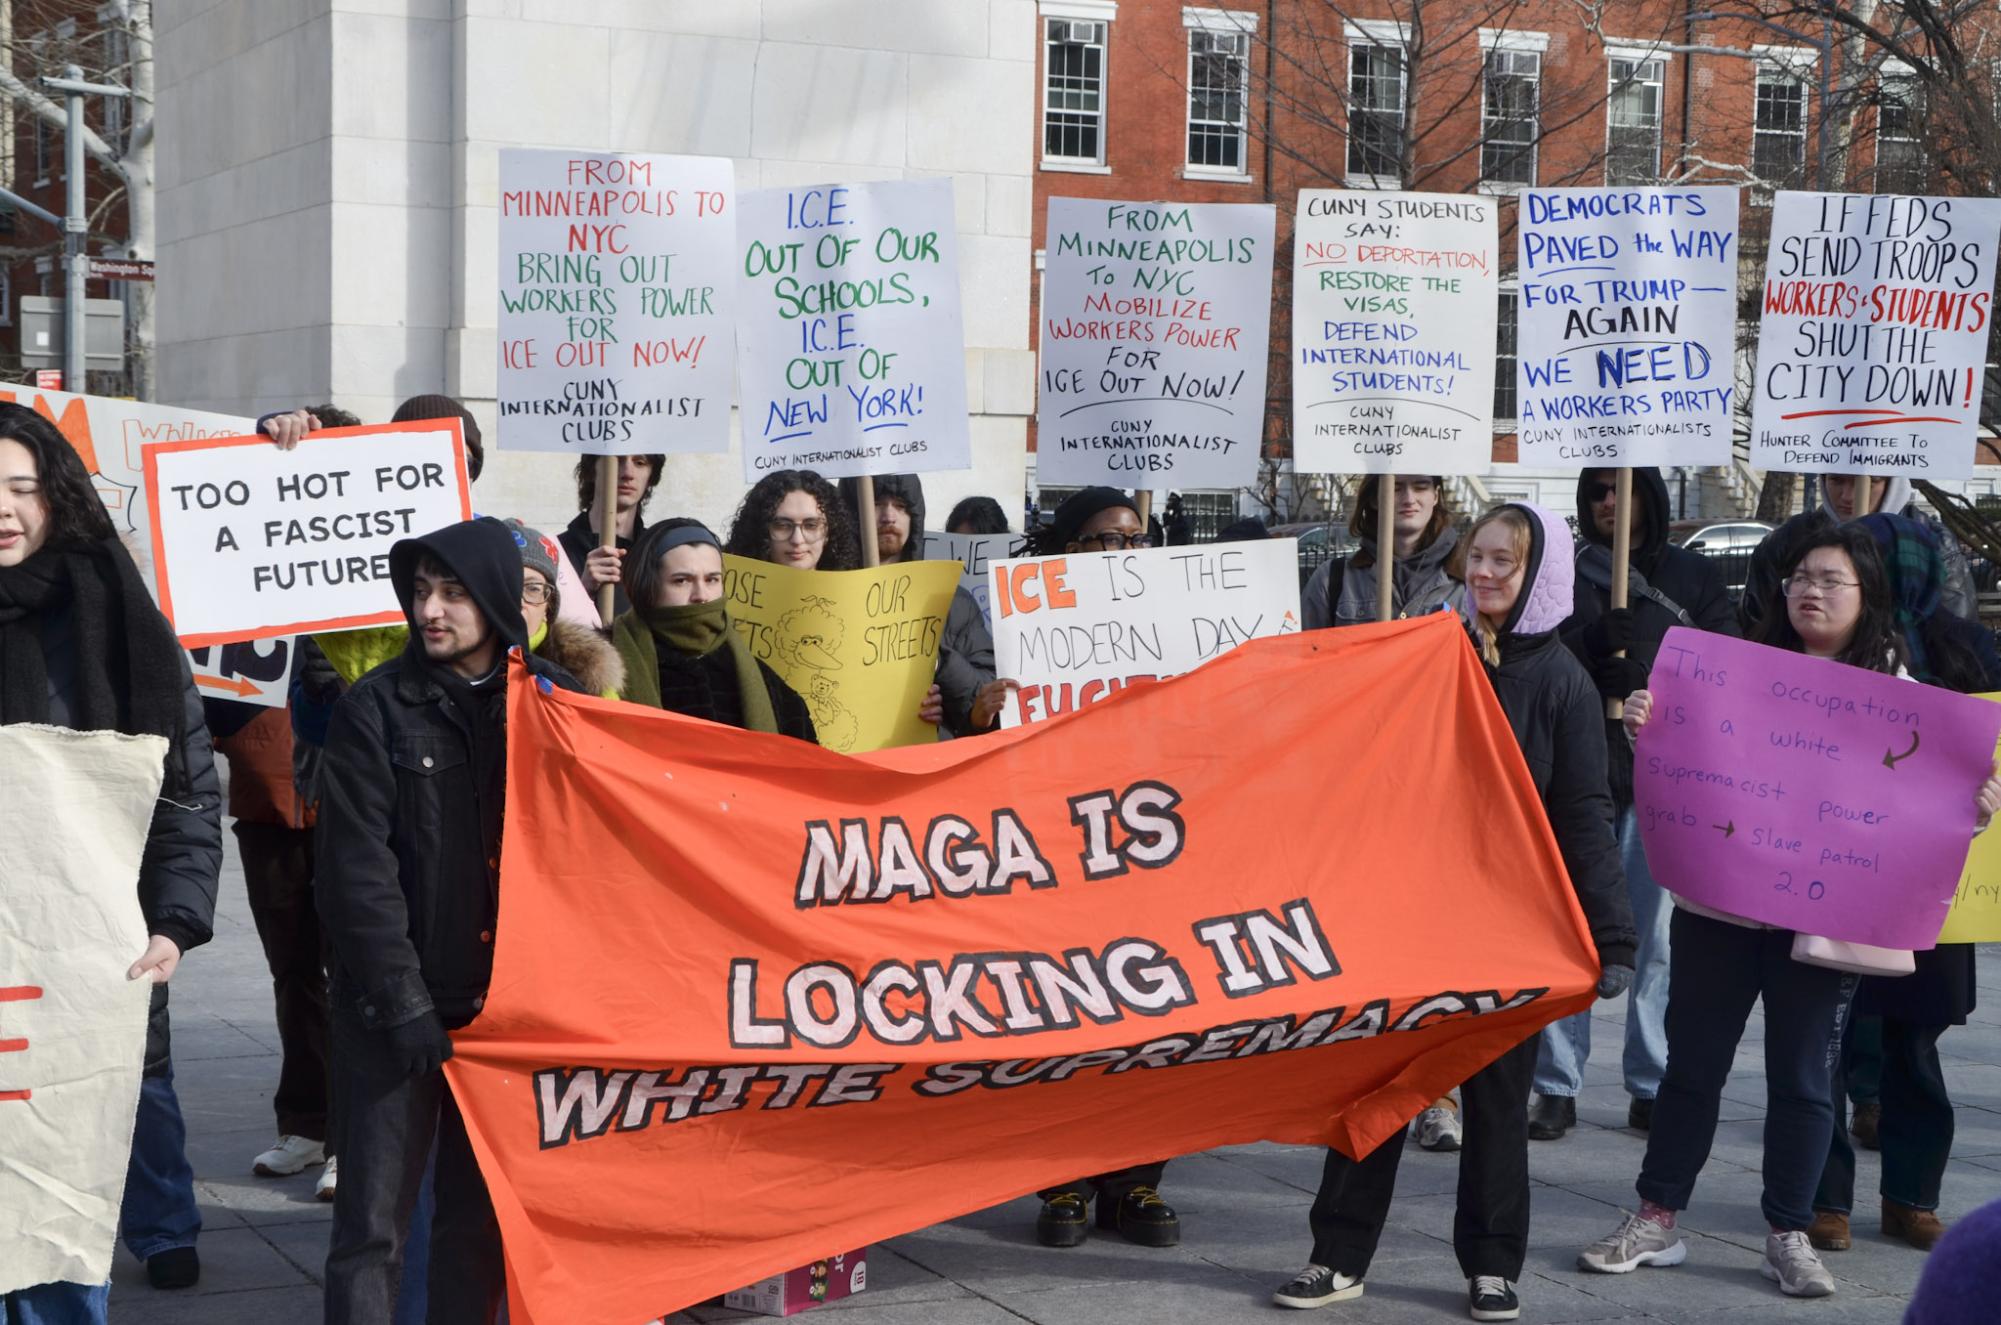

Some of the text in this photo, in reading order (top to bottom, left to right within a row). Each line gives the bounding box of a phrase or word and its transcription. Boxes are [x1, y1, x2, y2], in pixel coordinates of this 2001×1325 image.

[568, 160, 651, 186] FROM
[503, 190, 725, 217] MINNEAPOLIS TO
[787, 188, 854, 229] I.C.E.
[1108, 204, 1194, 233] FROM
[1308, 197, 1485, 223] CUNY STUDENTS
[1528, 193, 1707, 225] DEMOCRATS
[1813, 196, 1952, 242] IF FEDS
[568, 224, 629, 254] NYC
[1344, 223, 1400, 239] SAY:
[745, 227, 940, 278] OUT OF OUR
[1057, 232, 1255, 265] MINNEAPOLIS
[1306, 241, 1490, 277] NO DEPORTATION,
[1524, 228, 1733, 268] PAVED the WAY
[1779, 236, 1980, 289] SEND TROOPS
[91, 262, 139, 276] Washington
[518, 253, 679, 287] BRING OUT
[1133, 266, 1195, 296] NYC
[1319, 271, 1461, 293] RESTORE THE
[500, 287, 714, 317] WORKERS POWER
[774, 272, 929, 320] SCHOOLS,
[1084, 292, 1213, 321] MOBILIZE
[1344, 296, 1414, 319] VISAS,
[1524, 284, 1582, 308] FOR
[1765, 279, 1859, 319] WORKERS
[1870, 284, 1990, 333] STUDENTS
[567, 316, 618, 343] FOR
[802, 314, 865, 353] I.C.E.
[1049, 318, 1241, 351] WORKERS POWER
[1324, 321, 1418, 341] DEFEND
[1563, 304, 1680, 340] AGAIN
[503, 335, 706, 370] ICE OUT NOW!
[1107, 346, 1161, 371] FOR
[1794, 321, 1937, 364] SHUT THE
[786, 348, 898, 390] OUT OF
[1302, 348, 1471, 371] INTERNATIONAL
[1524, 341, 1712, 389] WE NEED
[563, 378, 623, 401] CUNY
[1100, 369, 1146, 394] OUT
[1161, 369, 1245, 400] NOW!
[1332, 371, 1454, 396] STUDENTS!
[1767, 362, 1973, 408] CITY DOWN!
[500, 397, 705, 417] INTERNATIONALIST
[764, 383, 923, 436] NEW YORK!
[1349, 406, 1394, 420] CUNY
[1523, 387, 1733, 423] A WORKERS PARTY
[562, 419, 634, 443] CLUBS
[1111, 419, 1153, 433] CUNY
[1314, 424, 1462, 441] INTERNATIONALIST
[1523, 422, 1712, 445] CUNY INTERNATIONALISTS
[1760, 431, 1811, 447] HUNTER
[1822, 430, 1899, 448] COMMITTEE
[754, 441, 928, 470] CUNY INTERNATIONALIST CLUBS
[1061, 434, 1238, 455] INTERNATIONALIST
[1354, 443, 1404, 456] CLUBS
[1559, 444, 1618, 460] CLUBS
[1784, 450, 1929, 468] DEFEND IMMIGRANTS
[1107, 453, 1174, 472] CLUBS
[171, 463, 445, 510] TOO HOT FOR
[215, 508, 416, 552] A FASCIST
[254, 554, 391, 592] FUTURE
[951, 541, 989, 575] WE
[723, 569, 767, 609] OSE
[866, 575, 911, 618] OUR
[995, 552, 1247, 619] ICE IS THE
[862, 616, 942, 666] STREETS
[1019, 613, 1264, 676] MODERN DAY
[1668, 645, 1920, 728] This occupation
[1664, 706, 1841, 762] is a white
[1818, 800, 1889, 825] power
[794, 779, 1185, 909] MAGA IS
[1645, 805, 1697, 832] grab
[1819, 848, 1880, 874] patrol
[1774, 871, 1825, 900] 2.0
[729, 897, 1342, 1049] LOCKING IN
[533, 985, 1551, 1150] WHITE SUPREMACY
